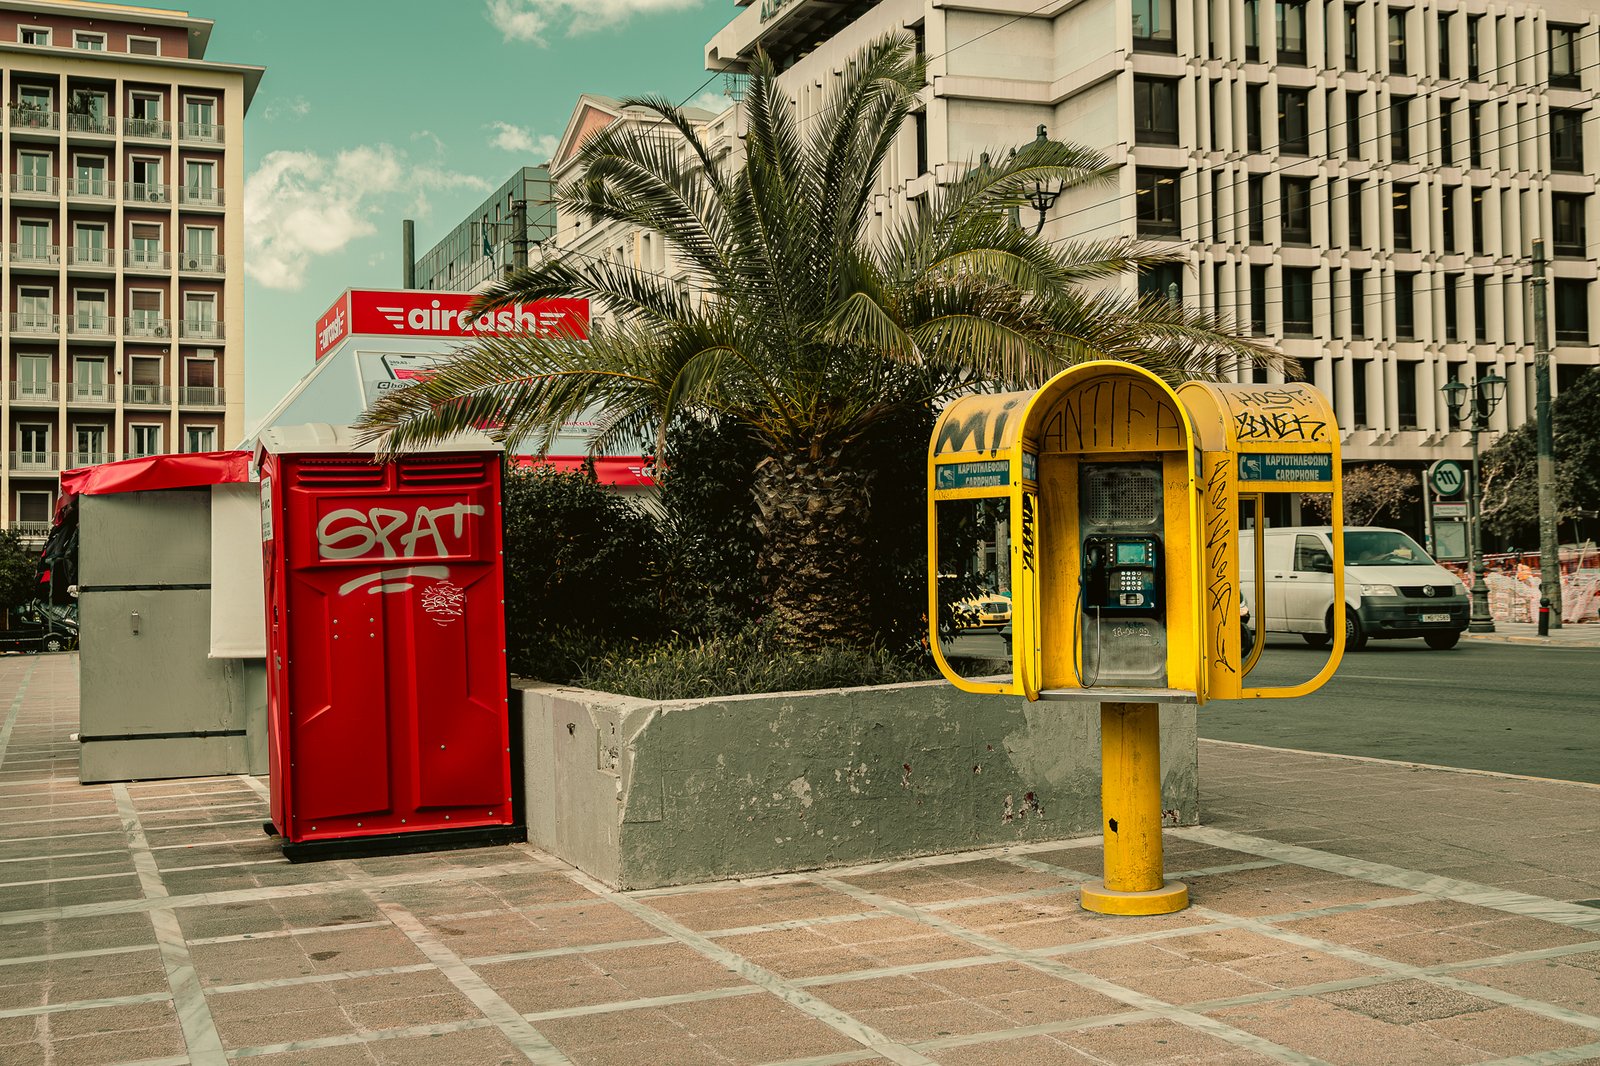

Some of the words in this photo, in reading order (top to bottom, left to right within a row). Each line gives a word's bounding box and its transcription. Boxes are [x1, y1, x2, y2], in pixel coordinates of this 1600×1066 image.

[408, 299, 537, 333] aircash
[1043, 380, 1181, 452] ANTIFA
[1275, 469, 1320, 481] CARDPHONE
